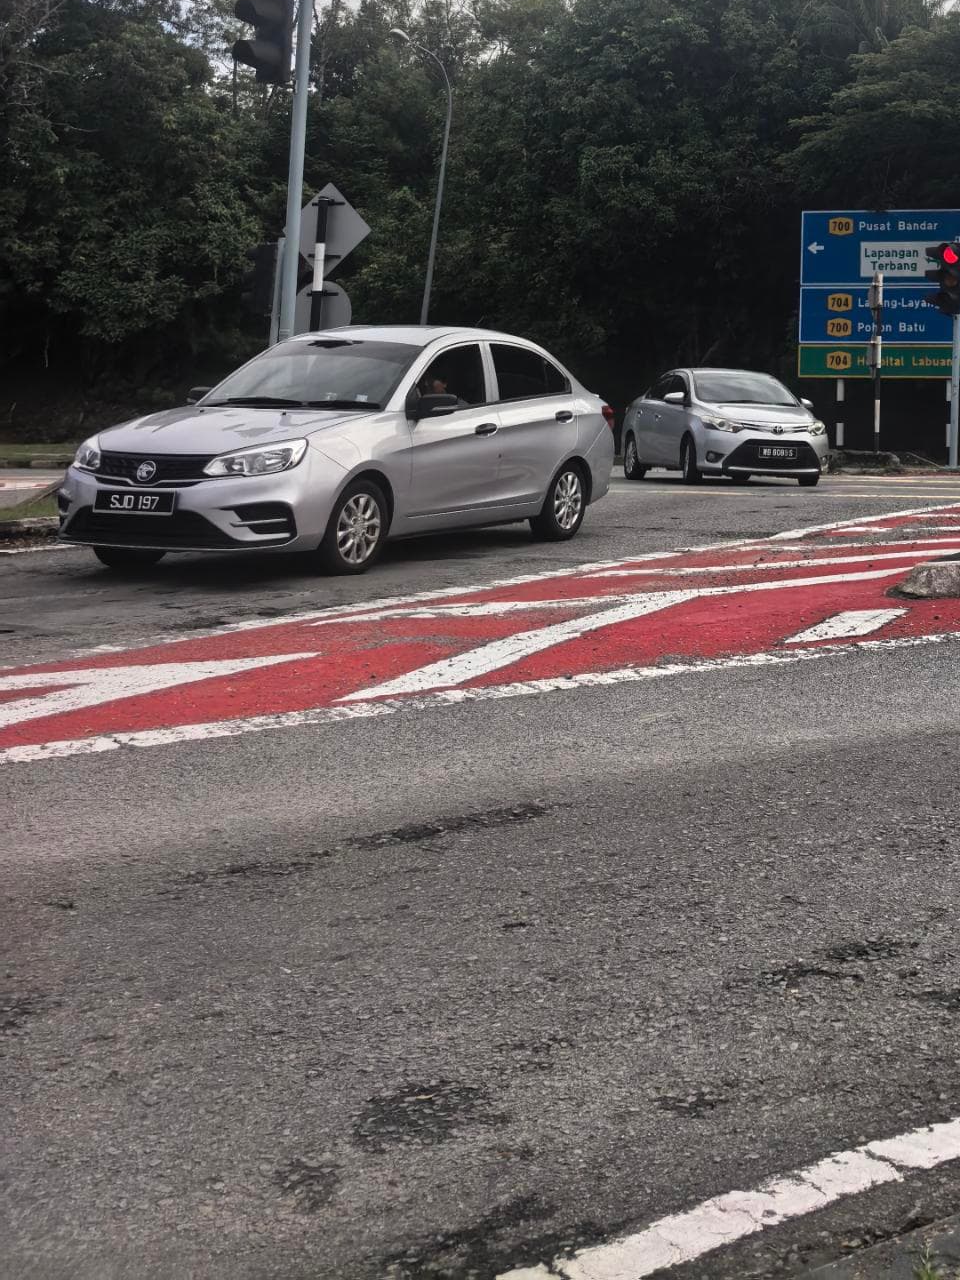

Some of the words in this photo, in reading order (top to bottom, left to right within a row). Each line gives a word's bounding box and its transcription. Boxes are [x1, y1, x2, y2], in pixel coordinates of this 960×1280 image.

[832, 221, 850, 231] 700
[859, 221, 891, 231] Pusat
[898, 220, 938, 231] Bandar
[864, 248, 919, 260] Lapangan
[870, 261, 918, 271] Terbang
[831, 297, 849, 308] 704
[830, 322, 849, 333] 700
[899, 322, 925, 333] Batu
[830, 356, 848, 366] 704
[138, 495, 160, 510] 197
